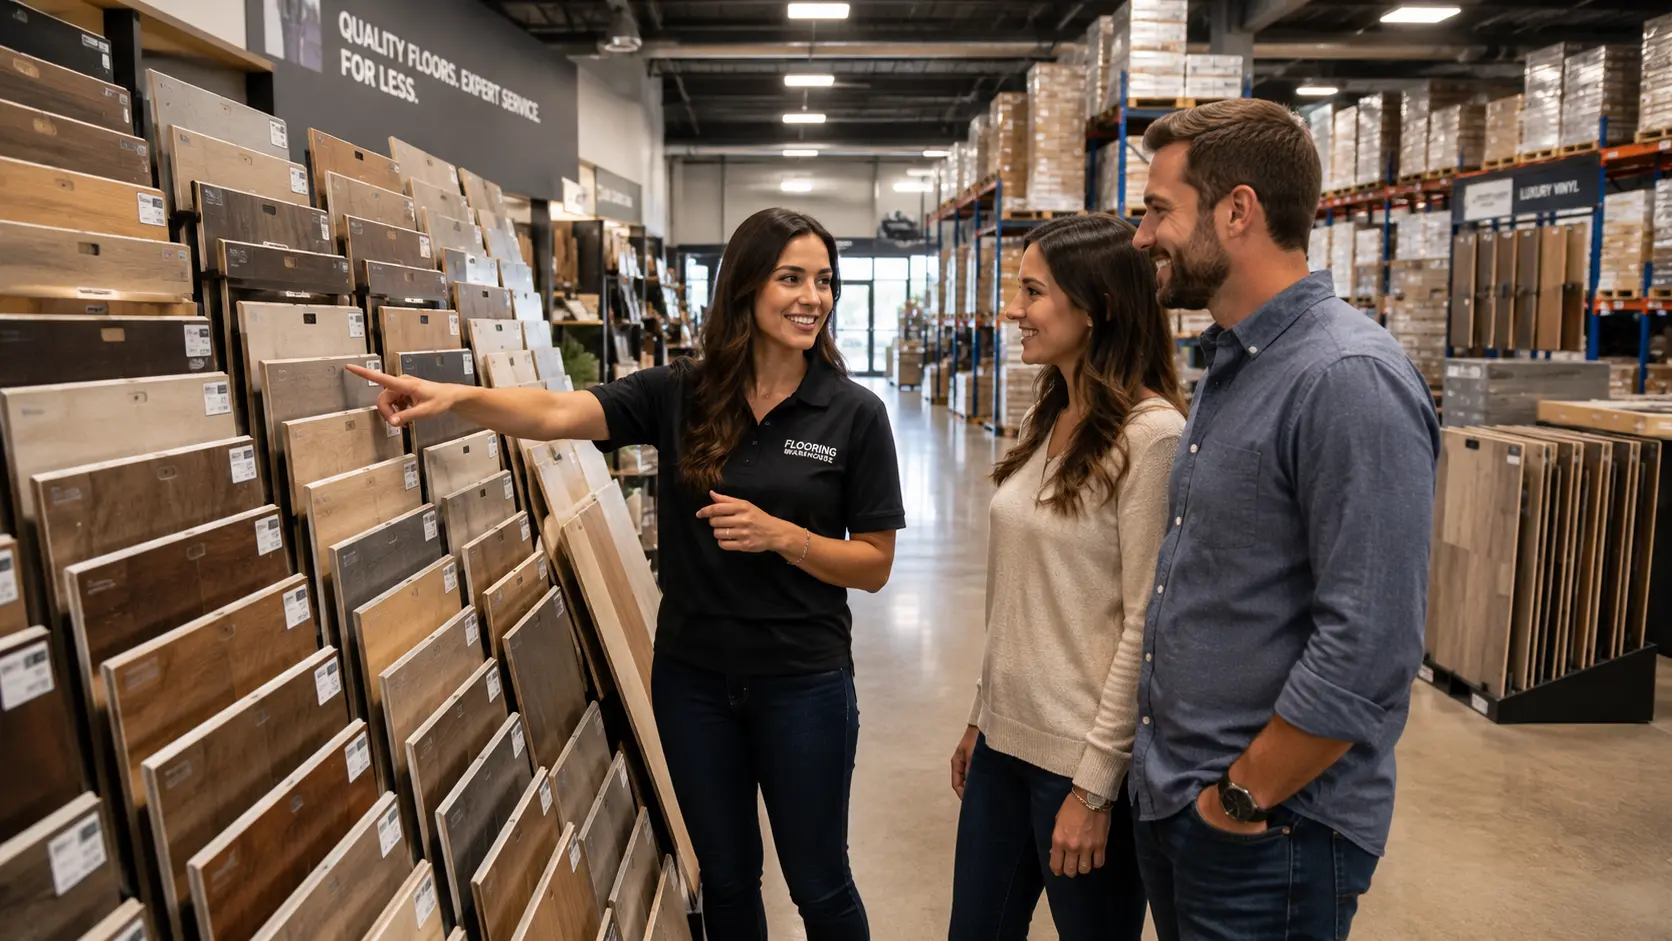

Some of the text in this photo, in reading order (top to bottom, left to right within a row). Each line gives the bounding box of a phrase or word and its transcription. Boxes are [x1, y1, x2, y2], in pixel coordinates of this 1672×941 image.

[338, 11, 541, 124] QUALITY FLOORS. EXPERT SERVICE.
[340, 48, 419, 104] FOR LESS.
[1519, 184, 1552, 201] LUXURY
[1554, 179, 1580, 195] VINYL
[784, 439, 837, 457] FLOORING
